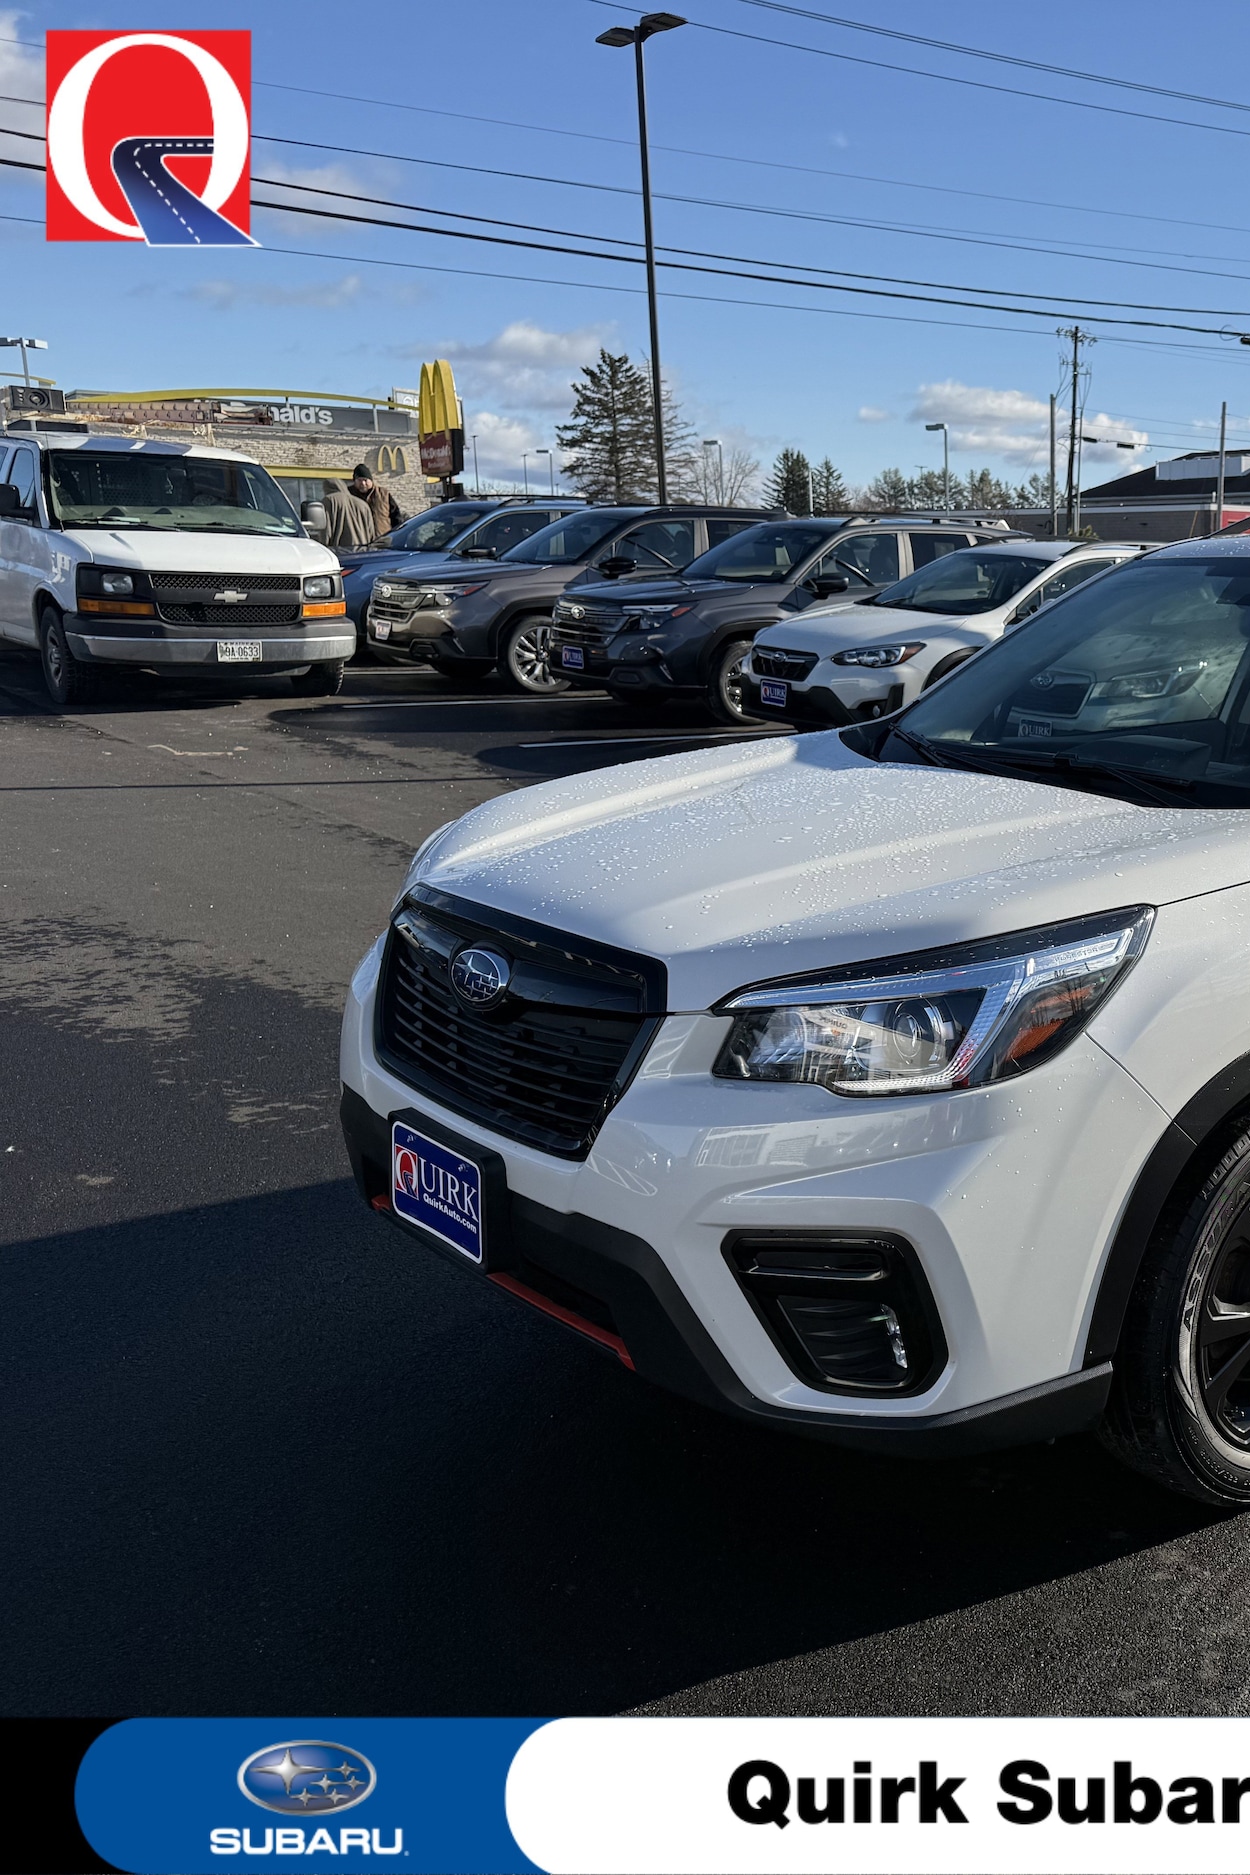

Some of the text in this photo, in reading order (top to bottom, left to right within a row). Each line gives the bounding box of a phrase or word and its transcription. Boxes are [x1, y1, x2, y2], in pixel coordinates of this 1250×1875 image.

[762, 685, 786, 698] QUIRK
[1020, 723, 1051, 737] QUIRK
[395, 1148, 480, 1223] QUIRK
[423, 1192, 478, 1235] QuirkAuto.com
